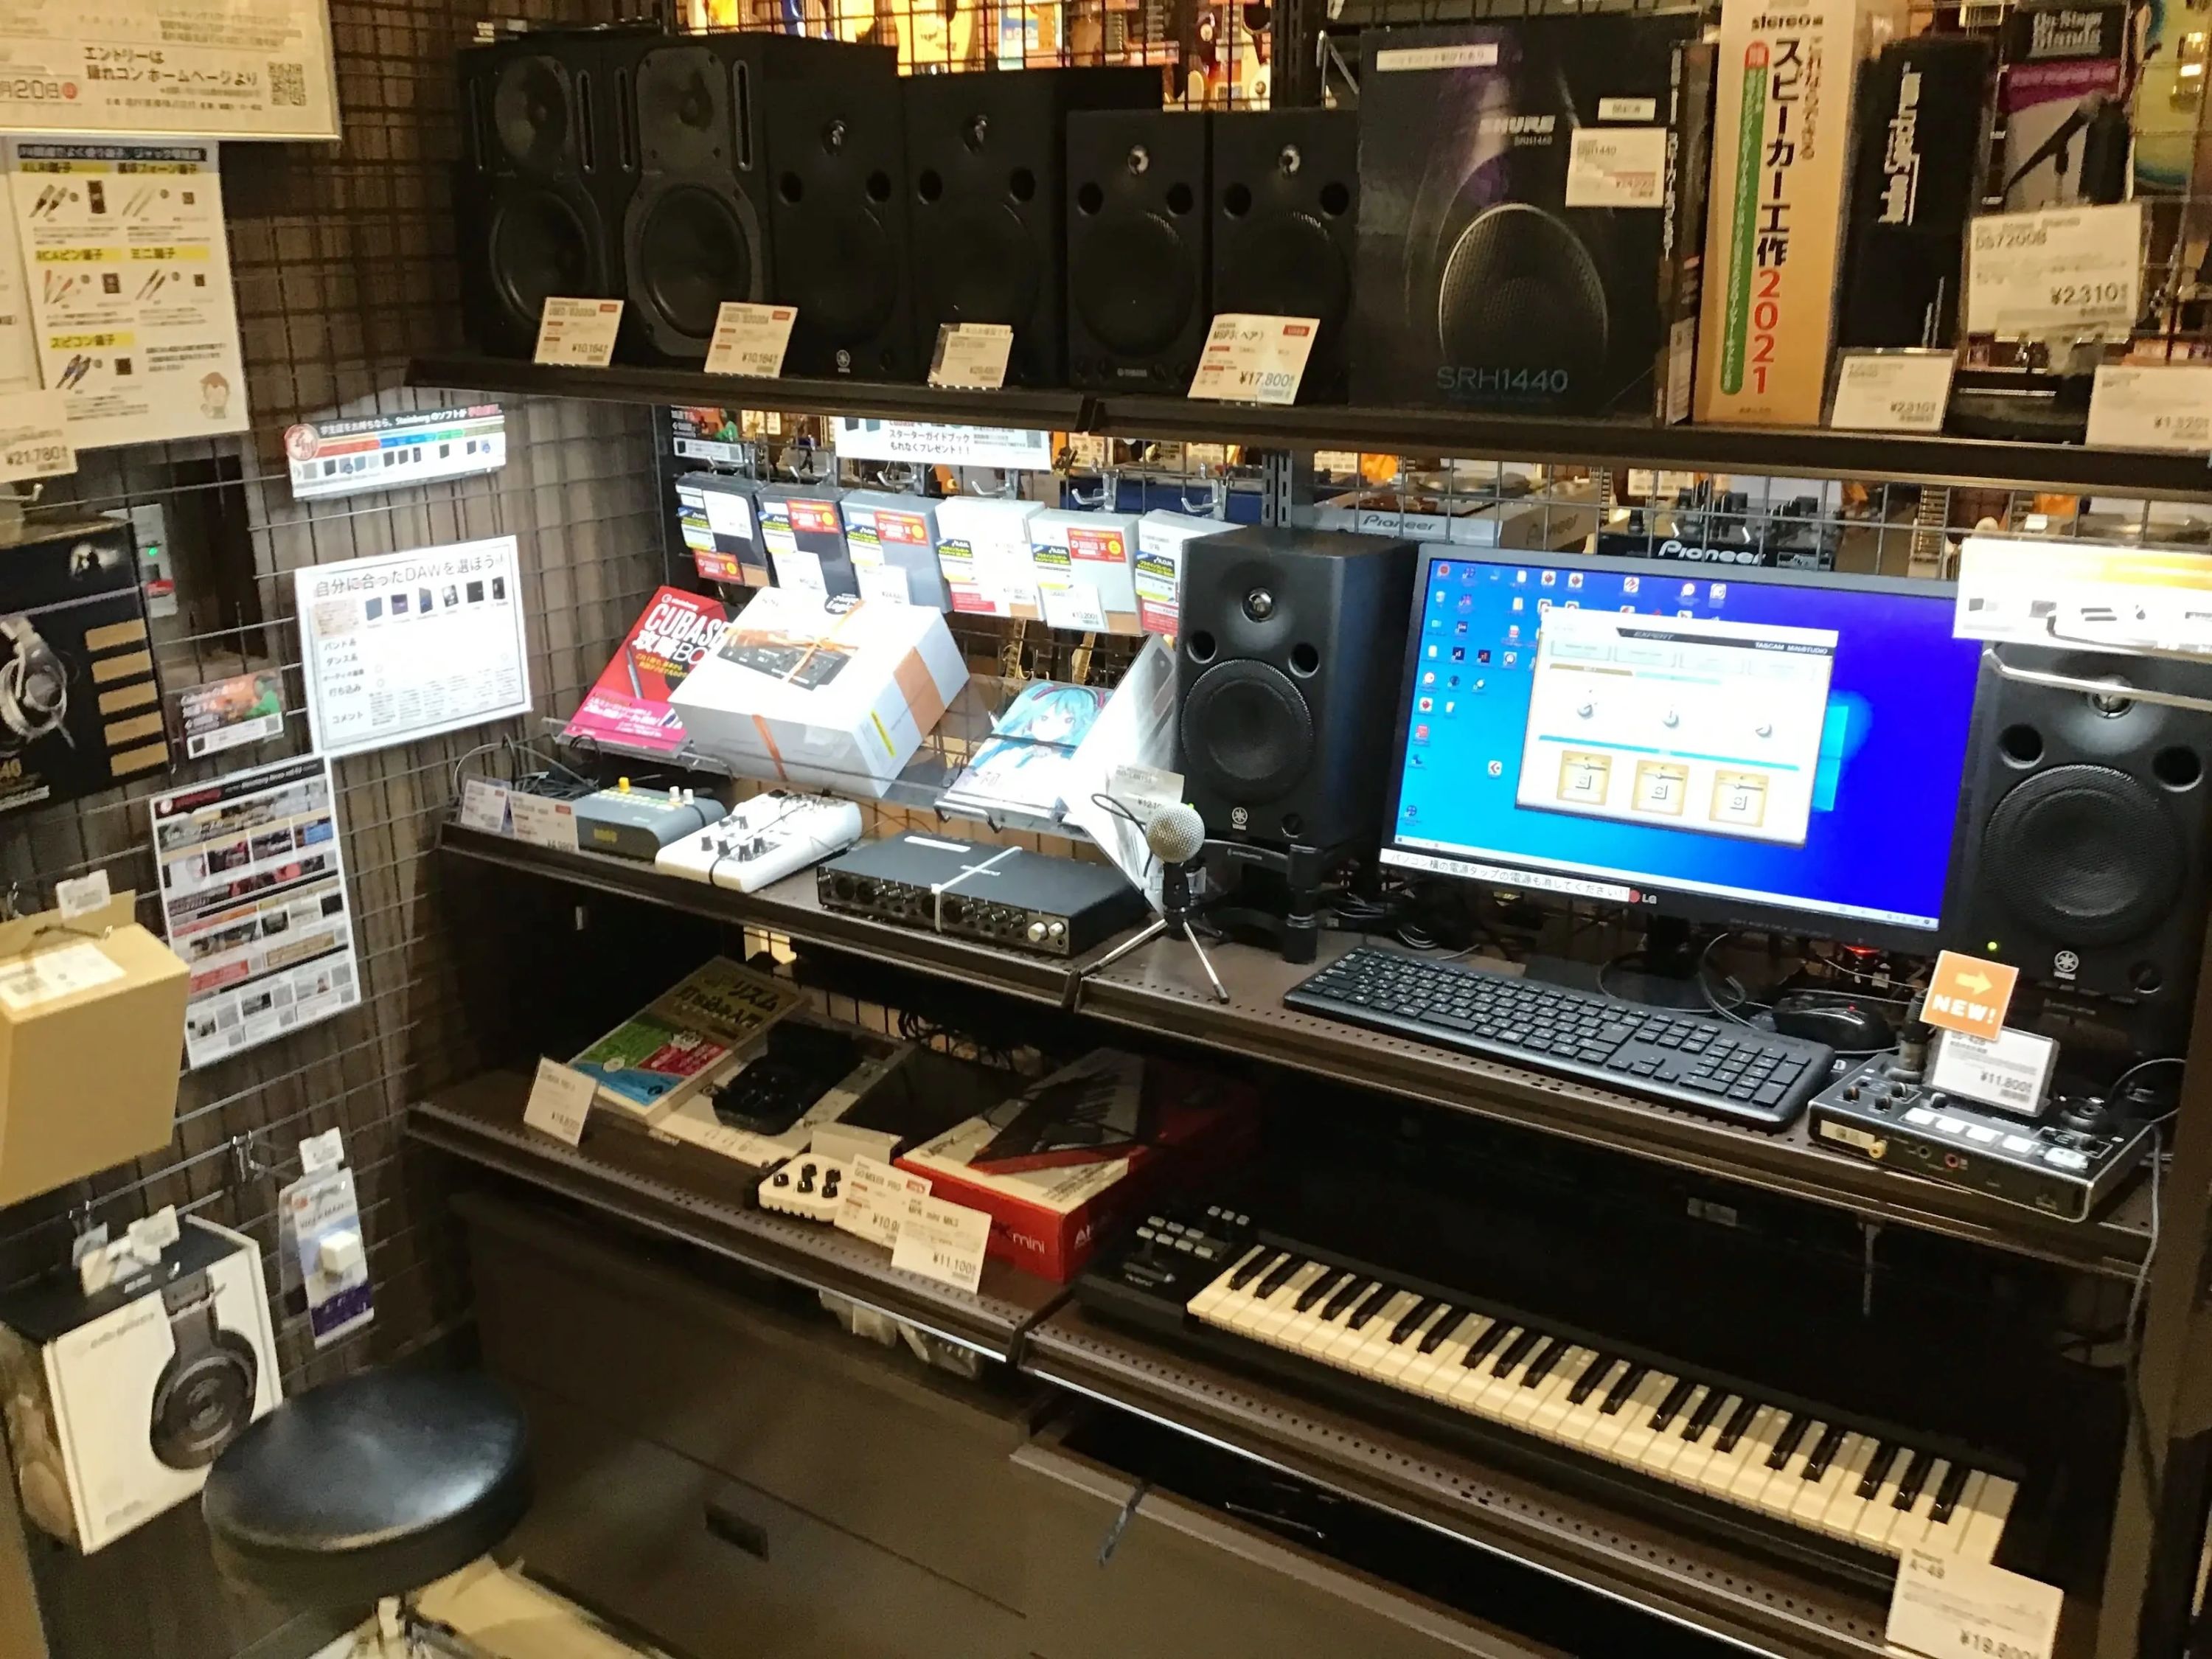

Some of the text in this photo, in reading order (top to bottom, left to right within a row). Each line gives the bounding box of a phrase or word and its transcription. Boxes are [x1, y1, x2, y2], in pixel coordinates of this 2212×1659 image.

[84, 47, 164, 64] エントリーは
[1751, 38, 1801, 394] スピーカー工作2021
[1437, 366, 1568, 394] SRH1440
[889, 429, 970, 443] スターターガイドブック
[1363, 515, 1436, 532] Pioneer
[1658, 540, 1767, 566] Pioneer
[644, 602, 732, 649] CUBASE
[1754, 641, 1784, 650] TASCAM
[333, 711, 364, 725] コメント
[1641, 893, 1658, 904] LG
[1931, 993, 1997, 1026] NEW!
[1013, 1232, 1045, 1255] mini
